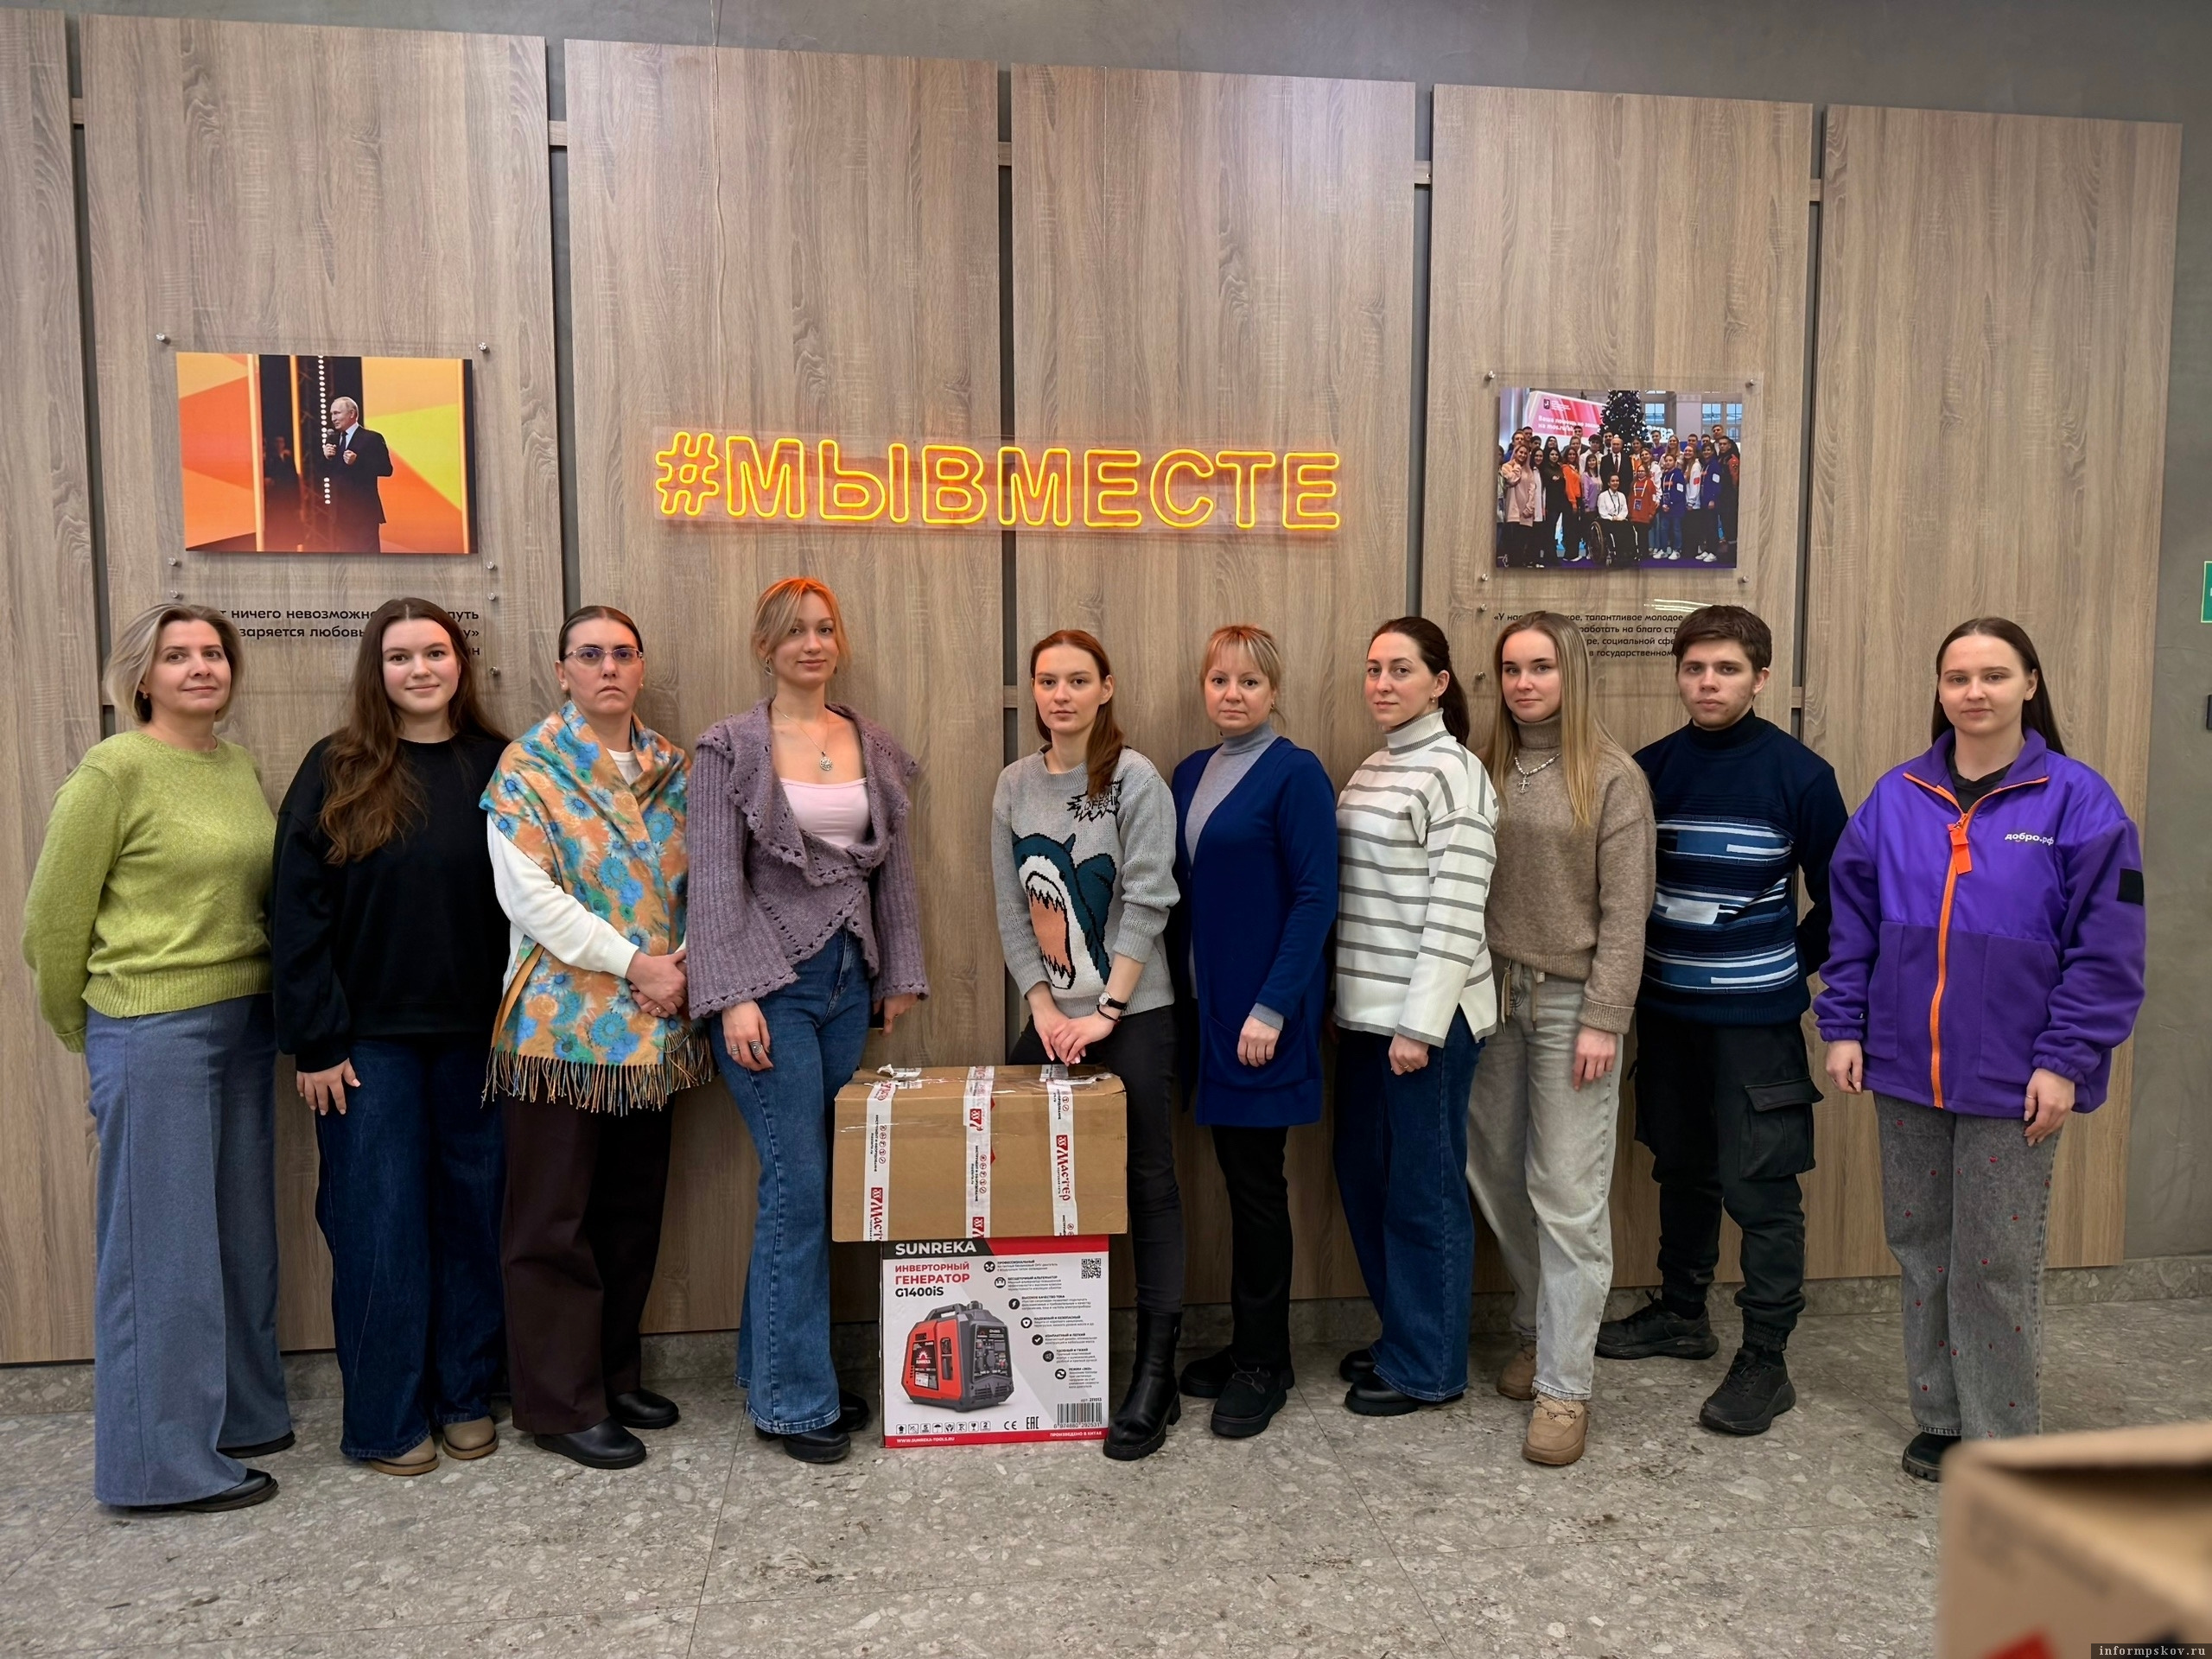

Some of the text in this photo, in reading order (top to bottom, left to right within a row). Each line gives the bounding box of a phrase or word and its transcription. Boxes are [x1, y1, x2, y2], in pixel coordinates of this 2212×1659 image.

[655, 431, 1340, 529] #МЫВМЕСТЕ
[232, 610, 281, 619] ничего
[448, 611, 479, 622] путь
[1494, 613, 1504, 621] «У
[239, 625, 365, 640] заряется любовь
[1636, 625, 1662, 633] благо
[1602, 637, 1656, 645] социальной
[2005, 832, 2054, 846] добро.рф
[870, 1202, 883, 1241] Маст
[895, 1241, 977, 1255] SUNREKA
[895, 1262, 969, 1273] ИНВЕРТОРНЫЙ
[895, 1274, 970, 1285] ГЕНЕРАТОР
[895, 1286, 944, 1298] G1400iS
